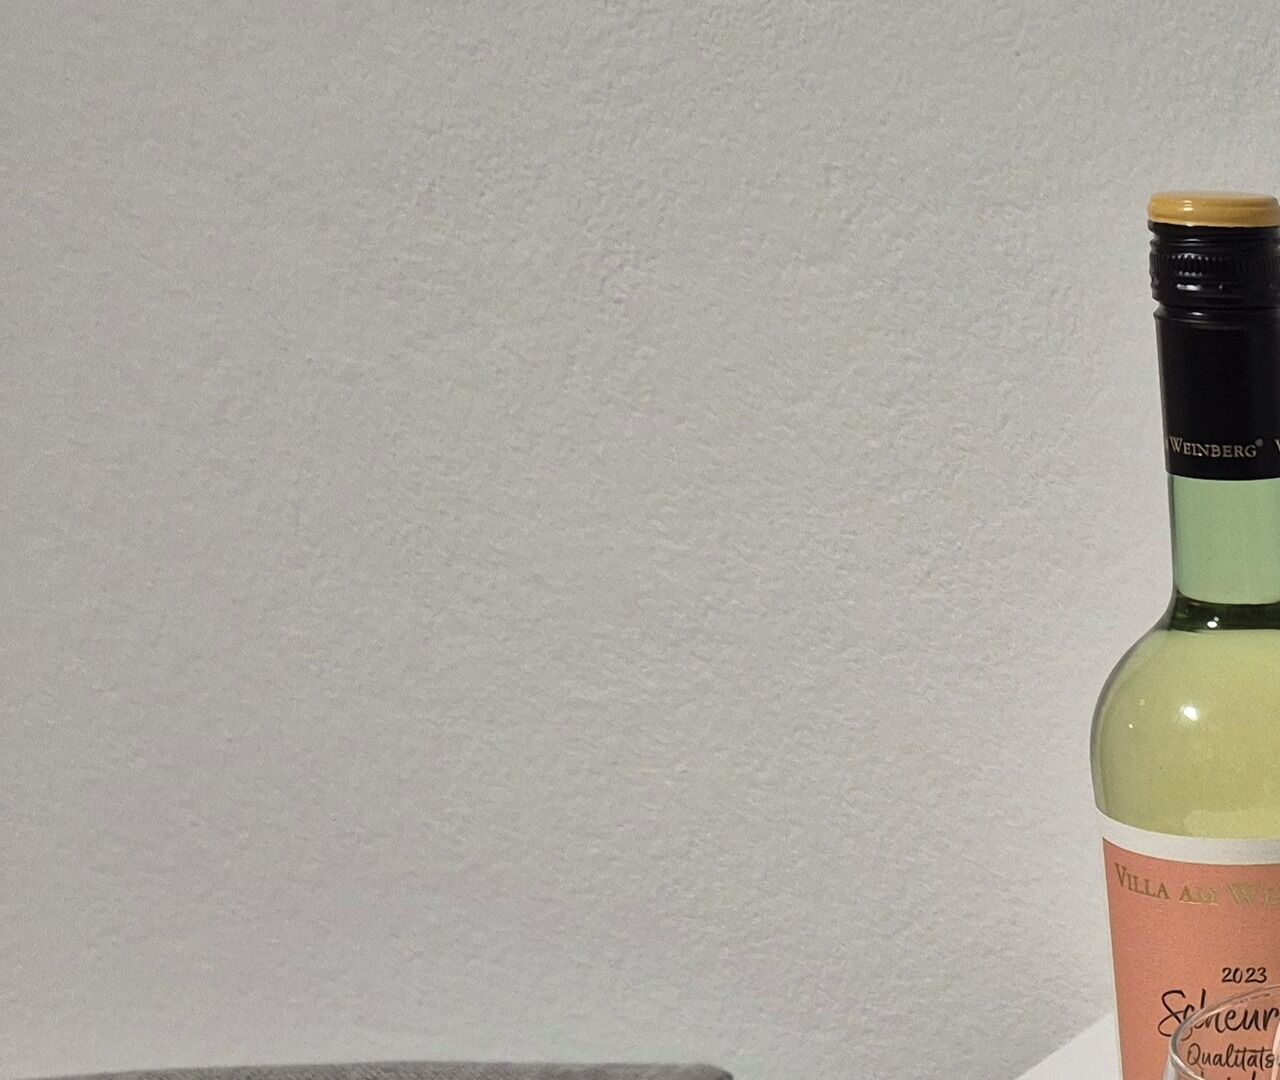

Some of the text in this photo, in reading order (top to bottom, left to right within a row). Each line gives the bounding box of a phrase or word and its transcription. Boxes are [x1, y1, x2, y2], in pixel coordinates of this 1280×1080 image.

[1114, 862, 1170, 900] VILLA
[1179, 884, 1218, 904] AM
[1222, 967, 1267, 983] 2023
